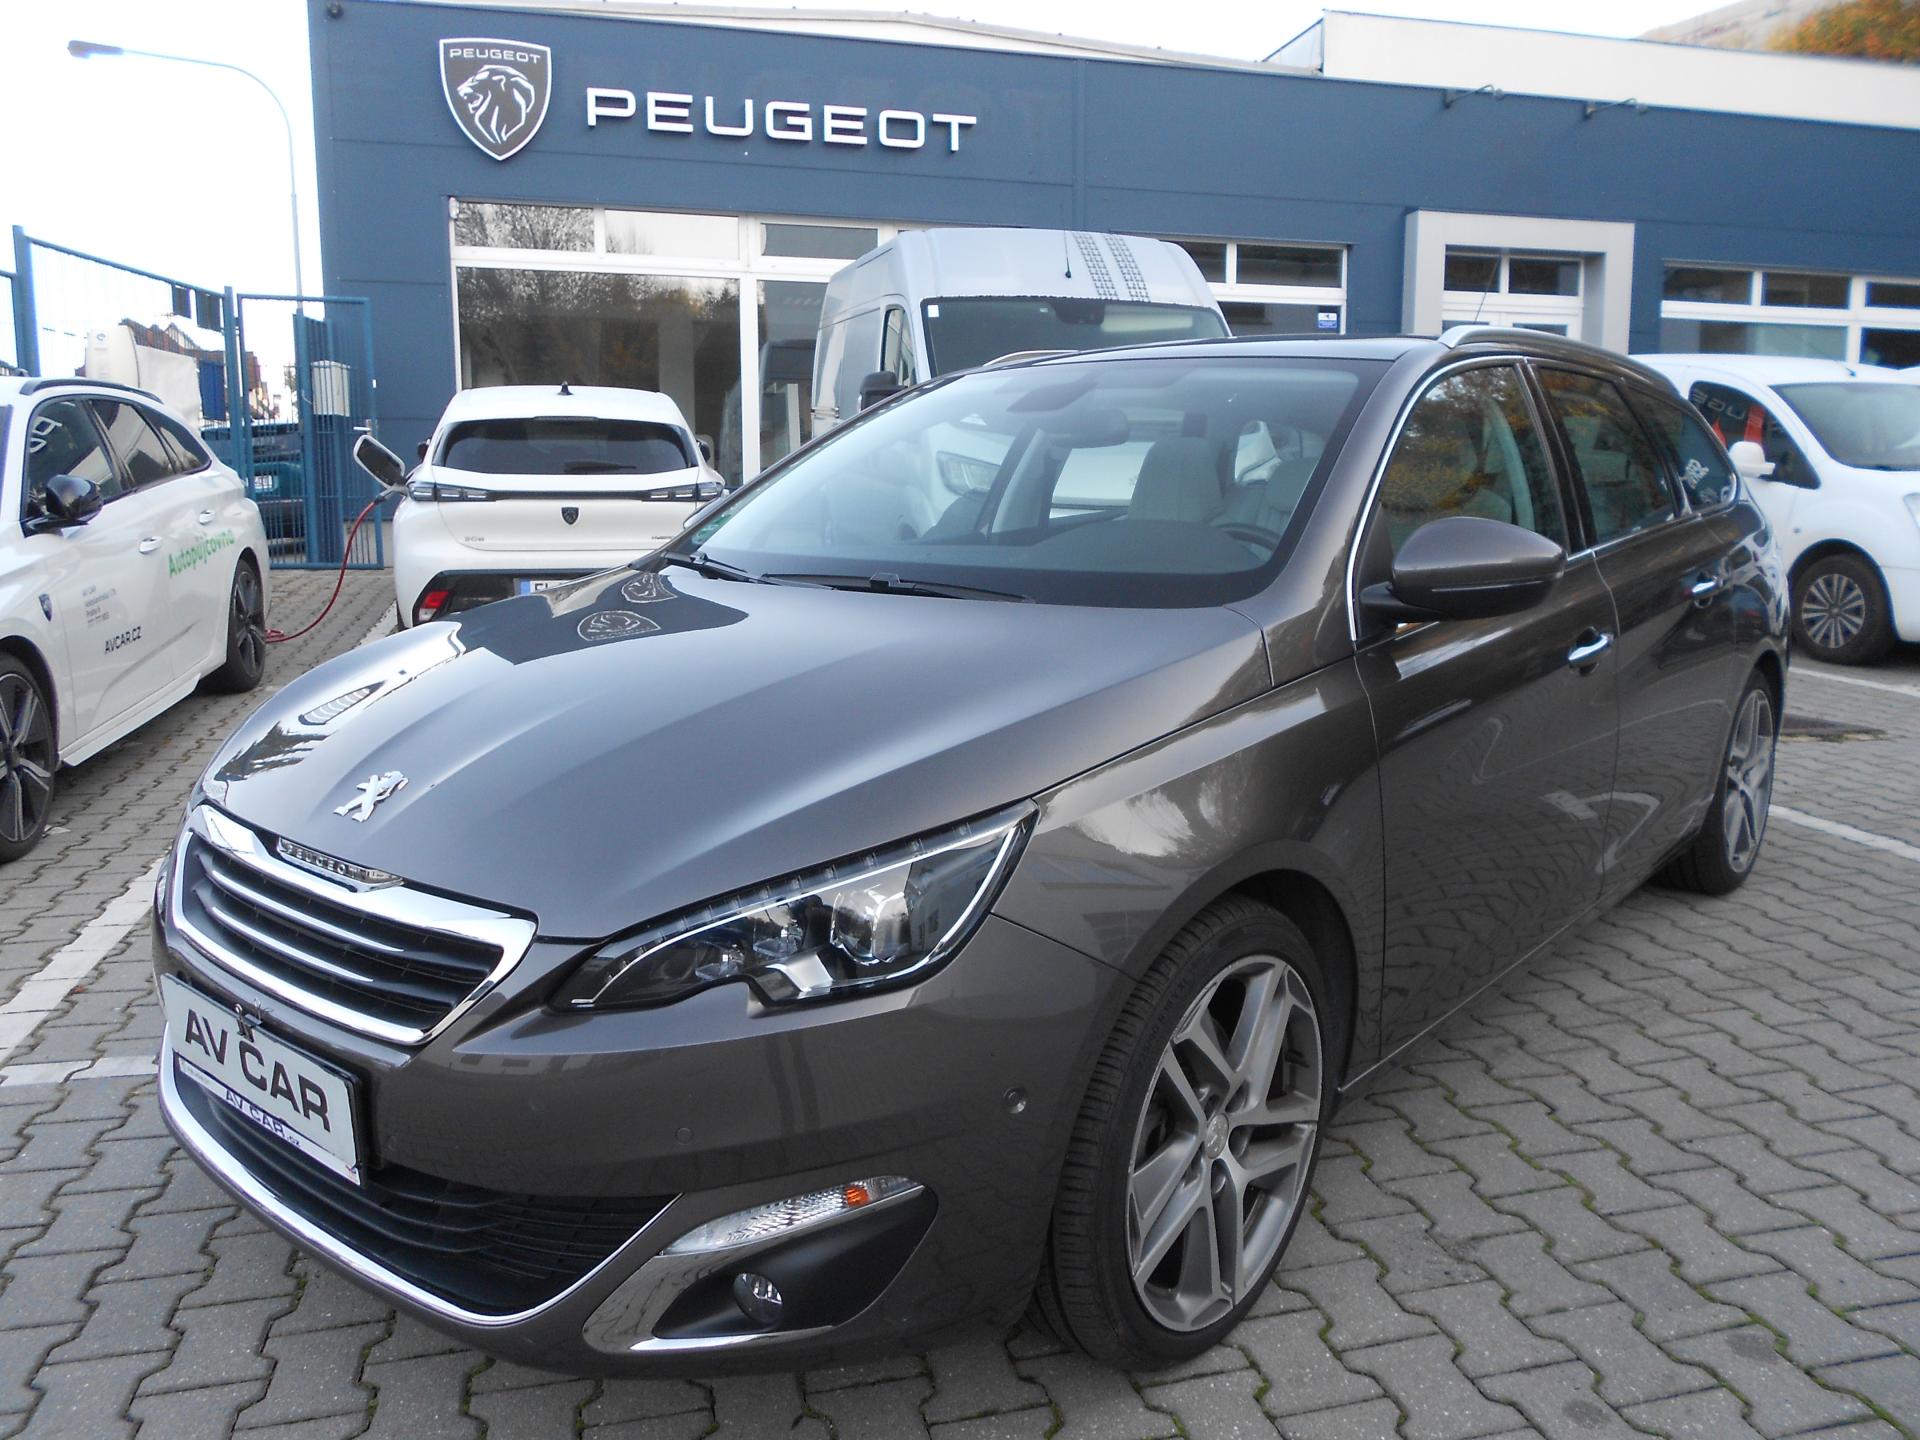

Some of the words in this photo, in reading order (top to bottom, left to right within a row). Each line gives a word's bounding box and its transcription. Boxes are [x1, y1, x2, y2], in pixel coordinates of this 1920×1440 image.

[450, 48, 541, 63] PEUGEOT
[586, 86, 977, 152] PEUGEOT
[285, 844, 357, 878] PEUGEOT
[185, 1009, 228, 1065] AV
[238, 1041, 331, 1133] CAR
[226, 1090, 243, 1109] AV
